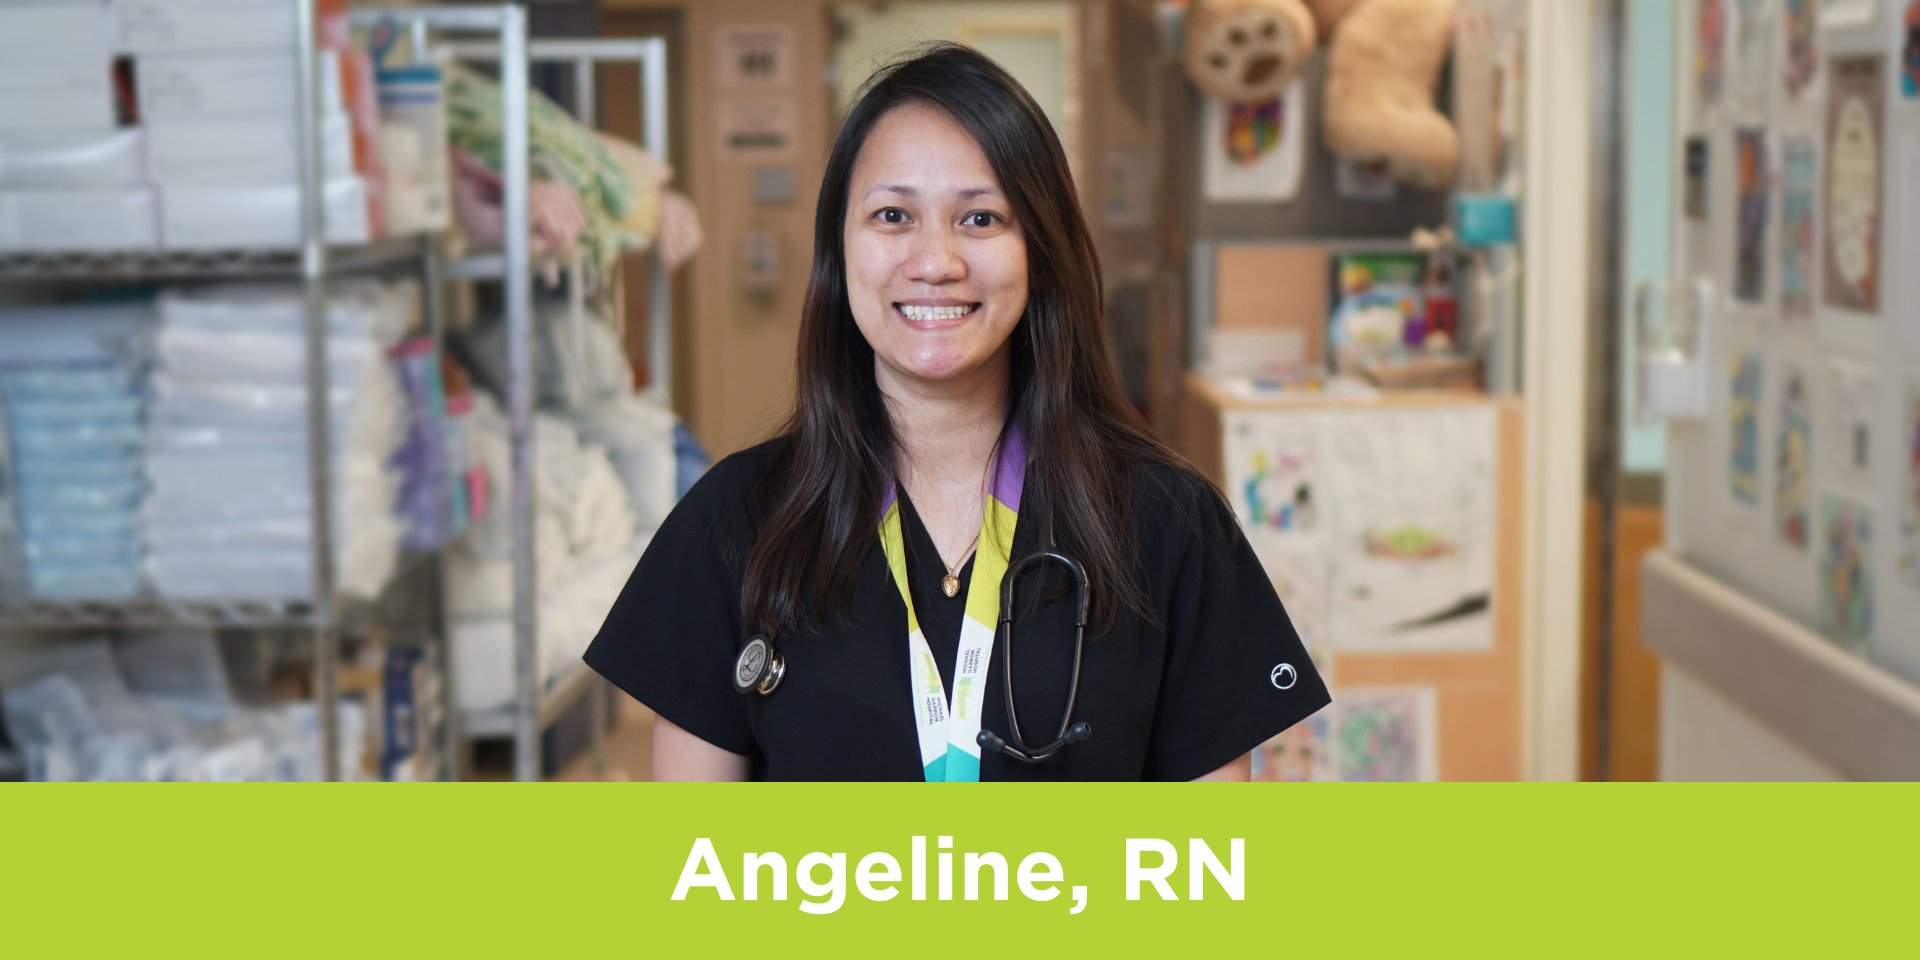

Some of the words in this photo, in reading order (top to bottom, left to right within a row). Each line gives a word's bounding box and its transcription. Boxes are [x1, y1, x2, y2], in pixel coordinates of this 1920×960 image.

[962, 648, 970, 674] MICHAEL
[972, 646, 982, 674] HOSPITAL
[936, 696, 944, 722] MICHAEL
